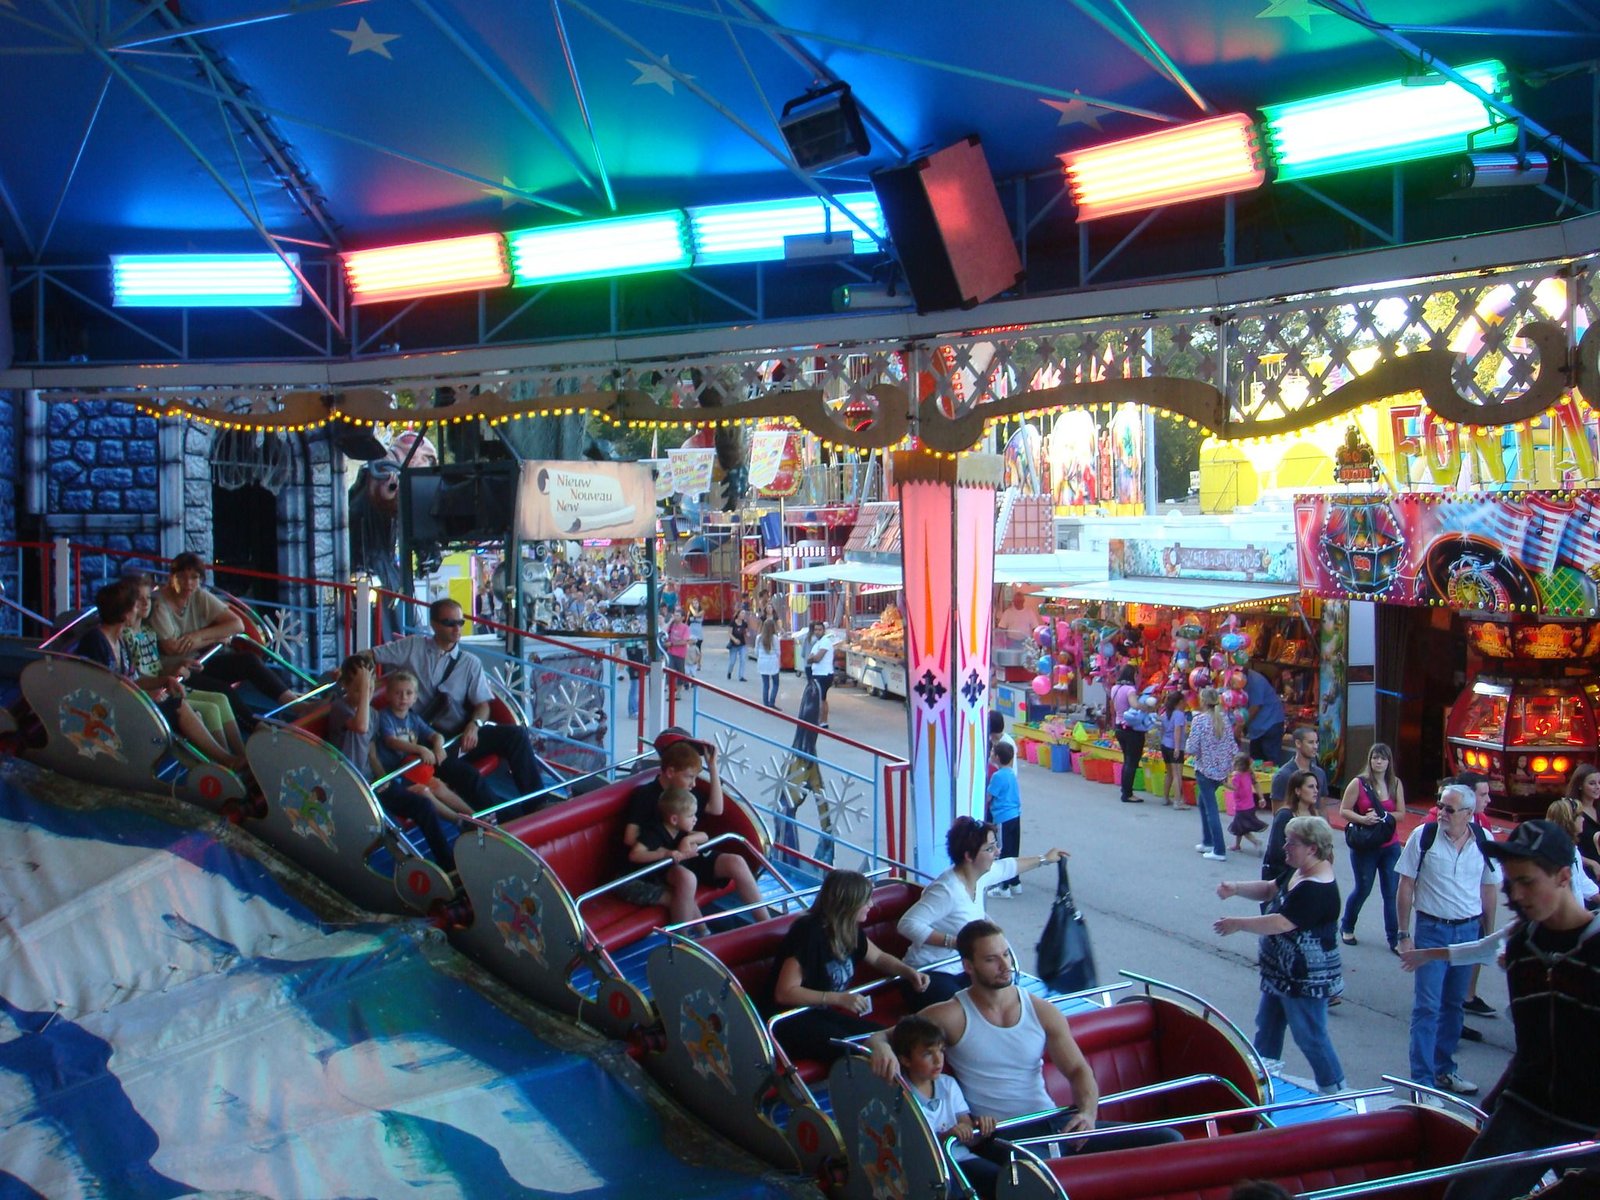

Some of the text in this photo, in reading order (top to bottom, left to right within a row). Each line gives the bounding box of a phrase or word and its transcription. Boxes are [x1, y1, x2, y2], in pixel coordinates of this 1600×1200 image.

[672, 455, 688, 463] ONE
[674, 464, 694, 476] SHOW
[557, 474, 591, 488] Nieuw
[570, 488, 612, 501] Nouveau
[557, 499, 579, 512] New
